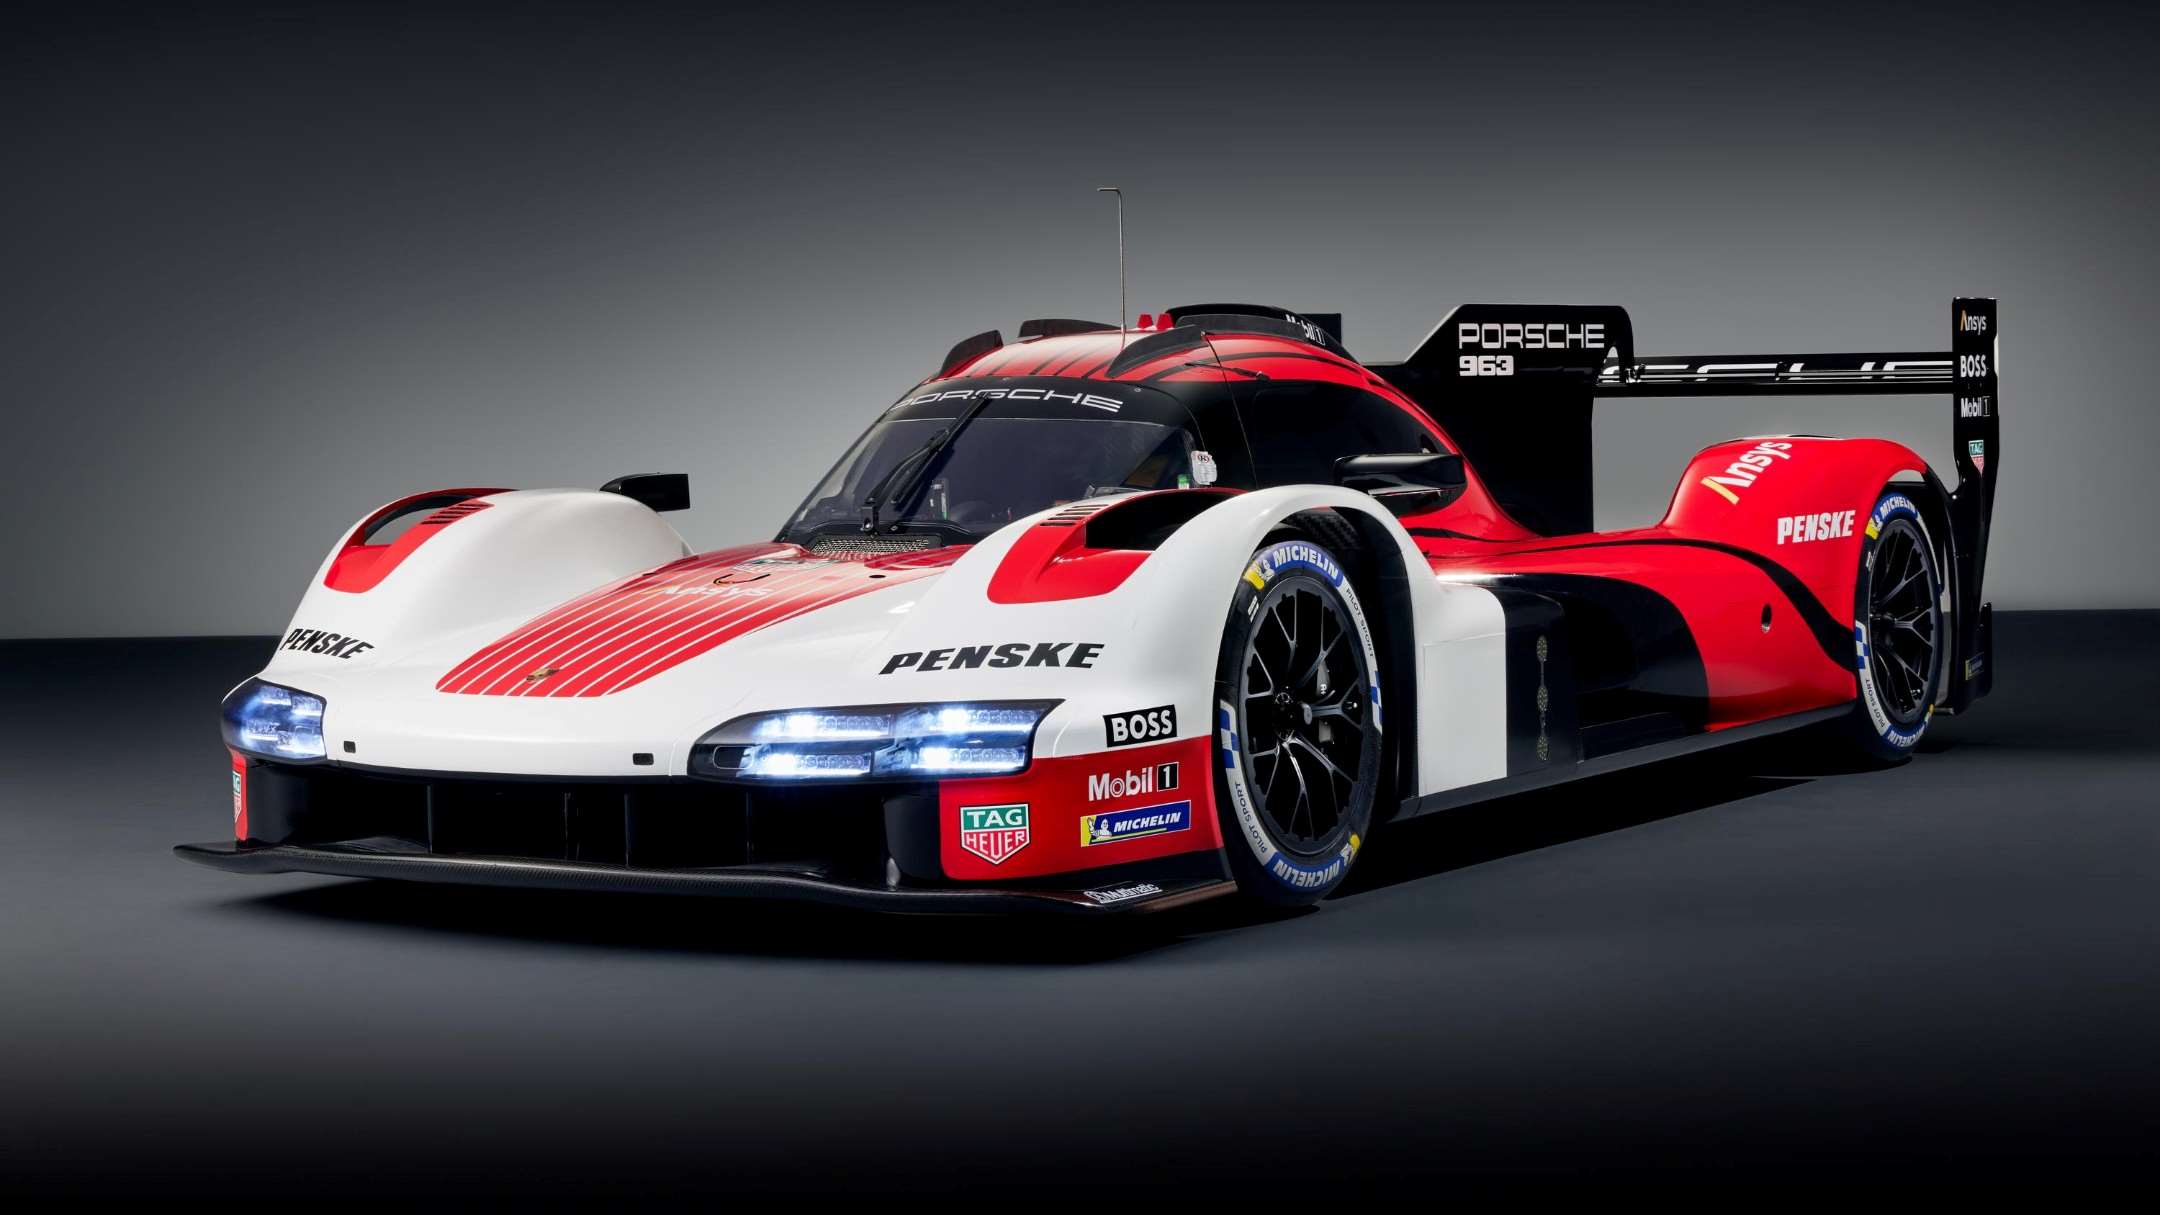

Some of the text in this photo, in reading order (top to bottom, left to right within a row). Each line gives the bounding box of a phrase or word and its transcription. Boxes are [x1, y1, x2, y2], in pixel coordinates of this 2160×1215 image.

[1458, 323, 1605, 349] PORSCHE
[1960, 310, 1987, 335] Ansys
[1459, 355, 1514, 376] 963
[1960, 355, 1987, 378] BOSS
[1961, 398, 1982, 418] Mobil
[1701, 441, 1793, 505] Ansys
[1880, 496, 1916, 519] MICHELIN
[1777, 510, 1856, 545] PENSKE
[1272, 545, 1339, 580] MICHELIN
[280, 628, 375, 659] PENSKE
[878, 642, 1105, 675] PENSKE
[1111, 709, 1173, 742] BOSS
[1088, 766, 1153, 801] Mobil
[966, 808, 1023, 828] TAG
[1113, 812, 1182, 833] MICHELIN
[1235, 781, 1268, 854] PILOT SPORT
[966, 830, 1025, 860] HEUER
[1273, 859, 1341, 887] MICHELIN
